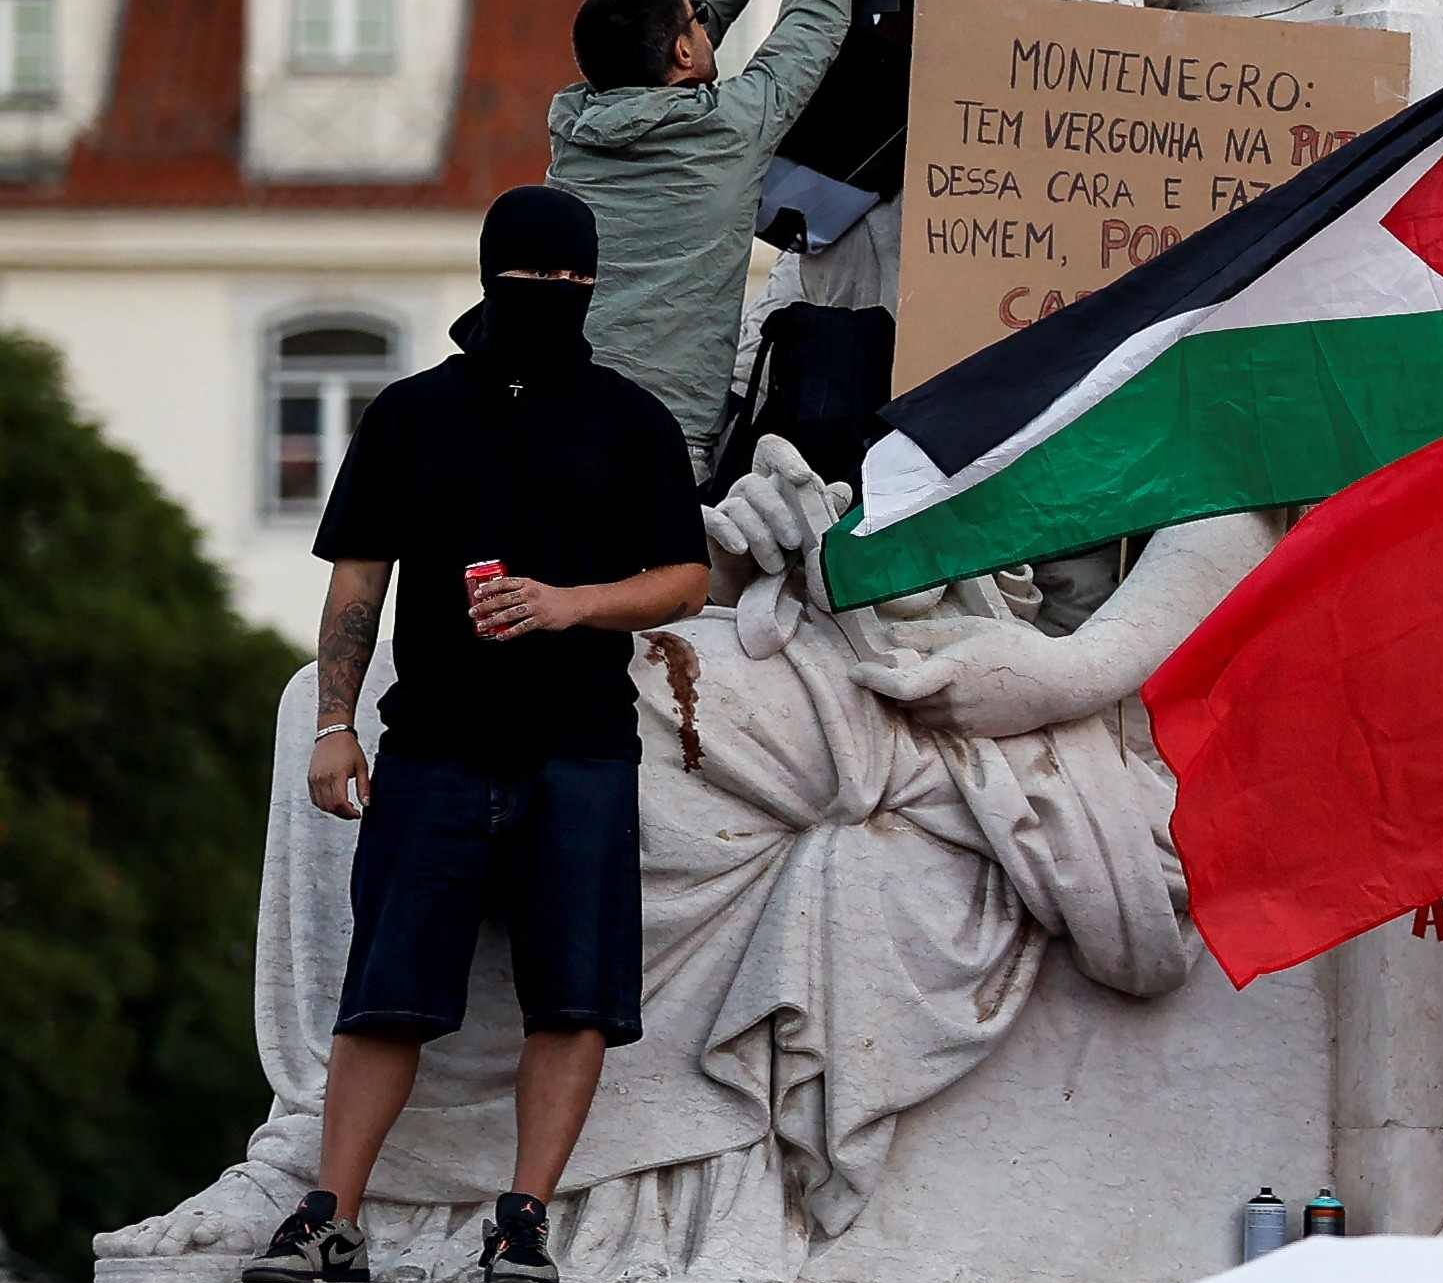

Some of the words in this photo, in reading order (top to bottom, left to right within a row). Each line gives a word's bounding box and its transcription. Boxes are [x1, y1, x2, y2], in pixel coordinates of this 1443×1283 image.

[1009, 38, 1317, 114] MONTENEGRO:
[954, 100, 1024, 148] TEM
[1044, 110, 1203, 165] VERGONHA
[1224, 126, 1272, 165] NA
[927, 163, 1023, 200] DESSA
[1046, 170, 1135, 209] CARA
[1163, 177, 1183, 209] E
[926, 218, 1069, 268] HOMEM,
